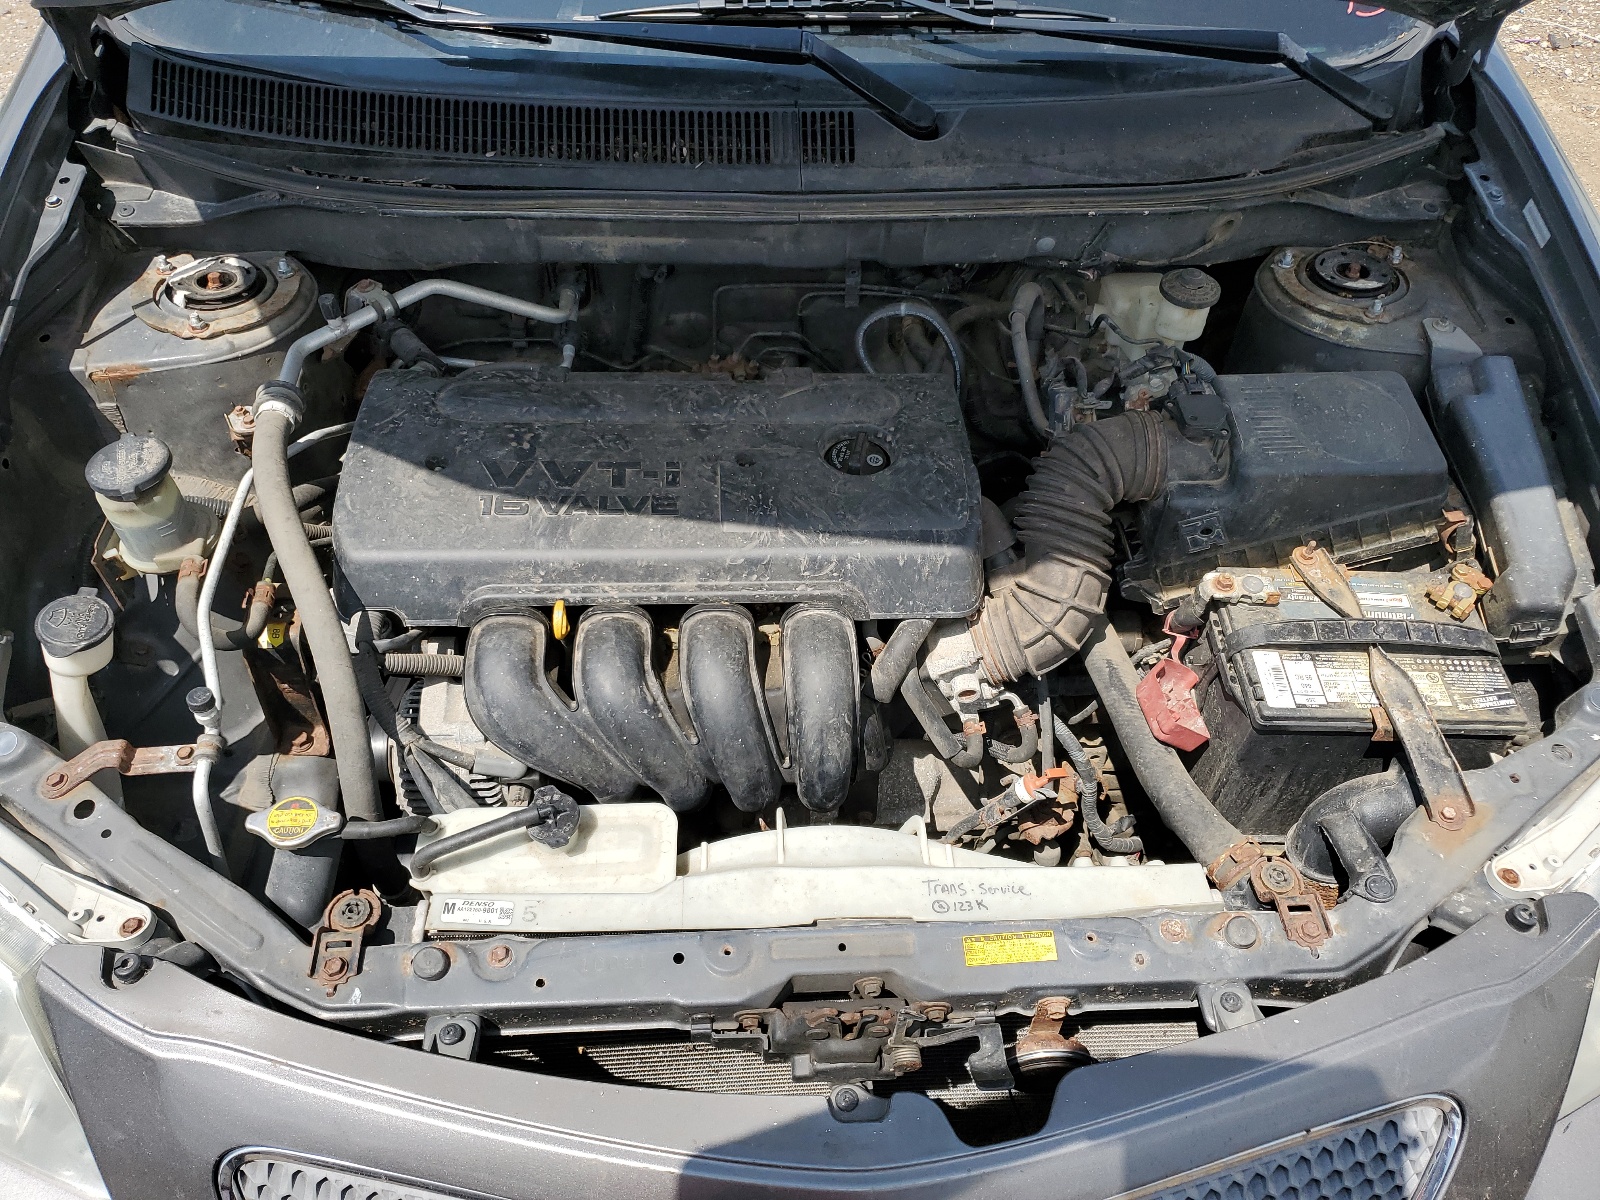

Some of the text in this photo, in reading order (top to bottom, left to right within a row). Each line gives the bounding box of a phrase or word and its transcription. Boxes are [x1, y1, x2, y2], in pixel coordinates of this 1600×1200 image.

[480, 460, 681, 489] VVT-i
[479, 494, 680, 517] 16 VALVE
[442, 902, 456, 915] M
